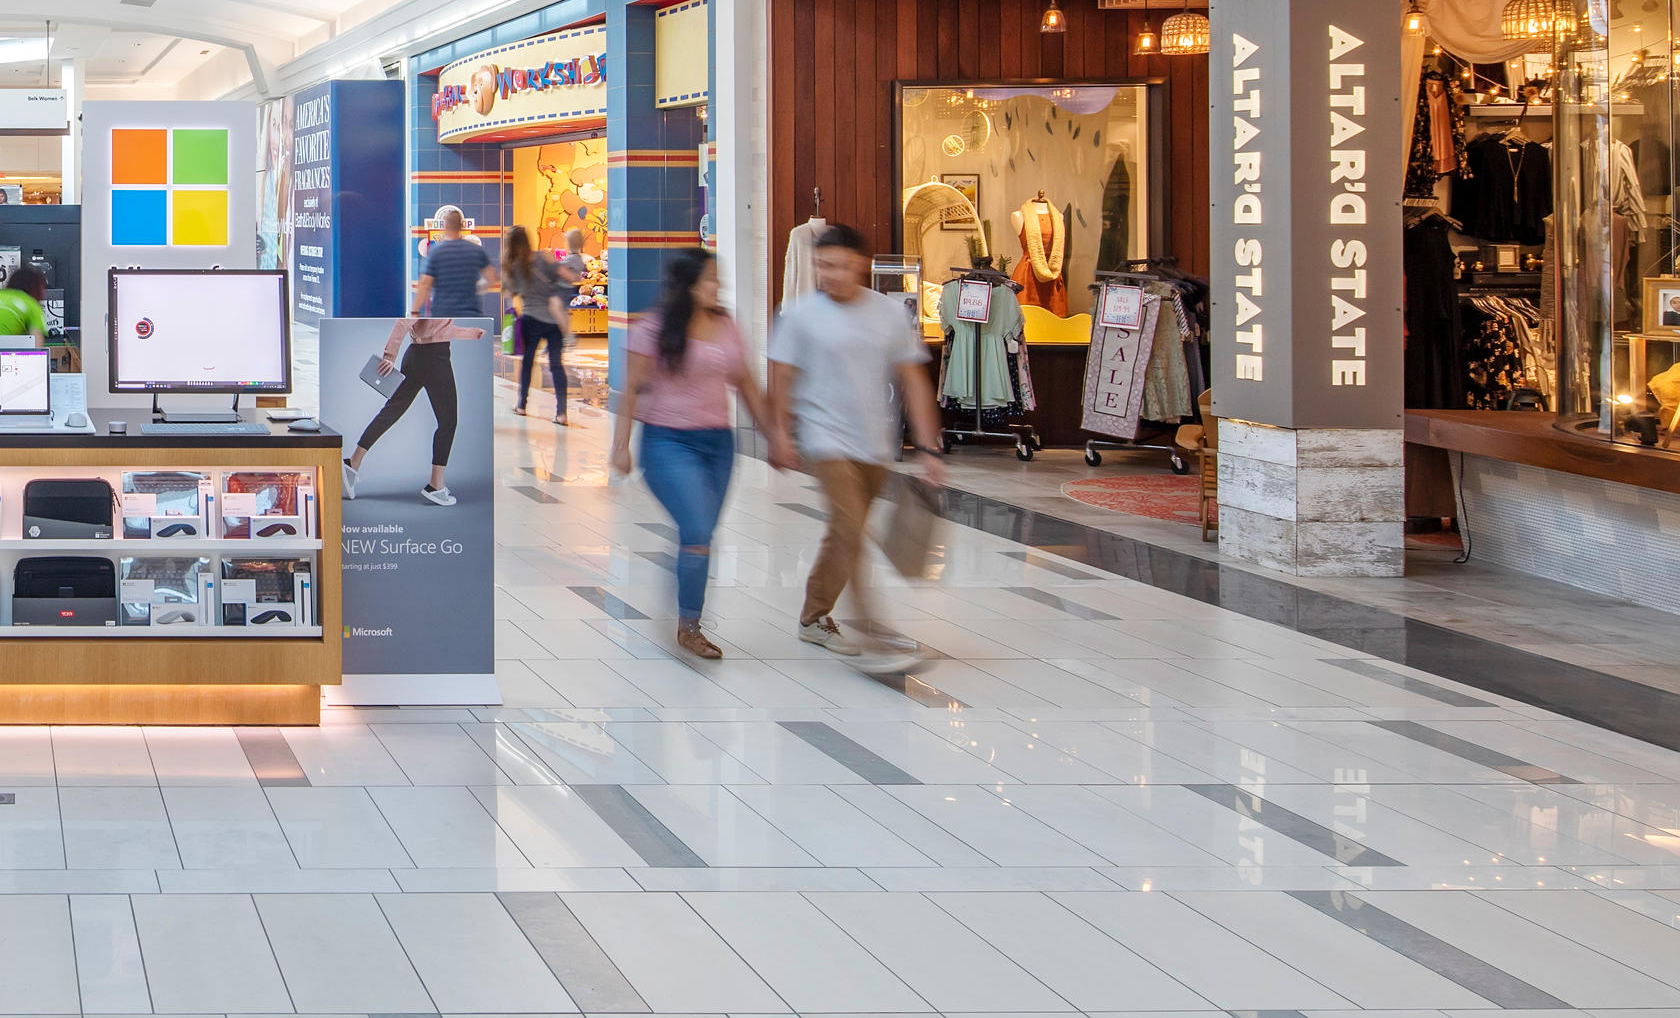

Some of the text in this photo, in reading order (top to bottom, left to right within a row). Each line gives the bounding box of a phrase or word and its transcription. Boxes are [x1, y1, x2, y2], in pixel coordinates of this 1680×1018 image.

[294, 94, 330, 132] AMERICA'S
[294, 130, 330, 165] FAVORITE
[294, 166, 330, 191] FRAGRANCES
[1234, 238, 1263, 381] STATE
[1331, 238, 1367, 385] STATE
[1105, 328, 1131, 409] SALE
[342, 524, 404, 533] Now available
[342, 538, 464, 555] NEW Surface Go
[342, 563, 362, 571] tarting
[370, 563, 382, 571] just
[382, 563, 398, 571] $399
[352, 627, 393, 637] Microsoft
